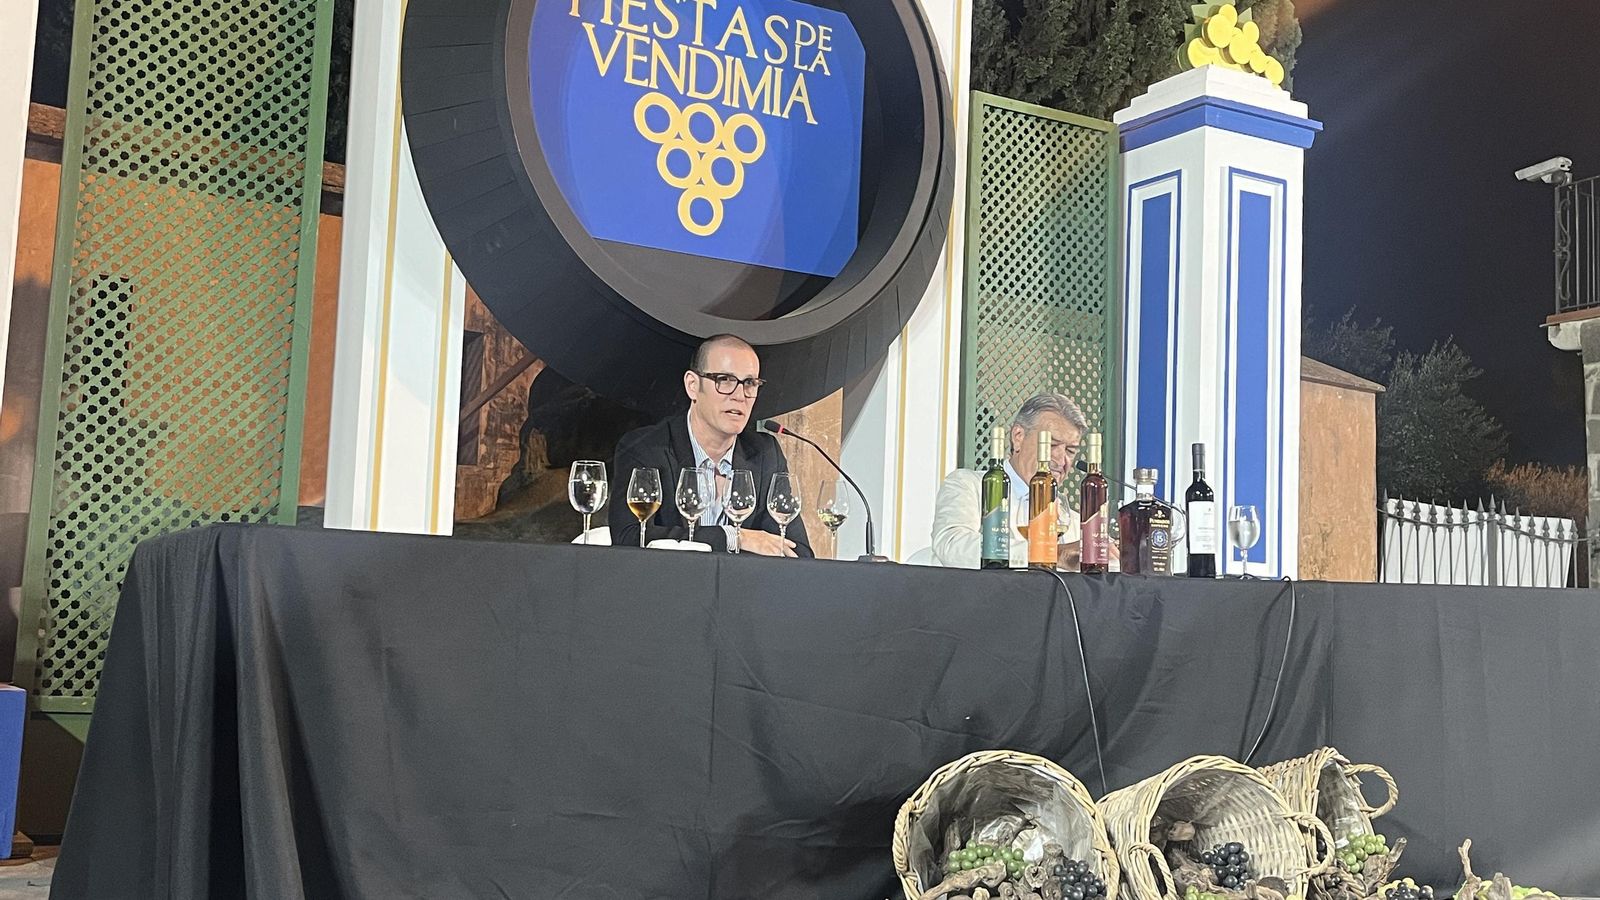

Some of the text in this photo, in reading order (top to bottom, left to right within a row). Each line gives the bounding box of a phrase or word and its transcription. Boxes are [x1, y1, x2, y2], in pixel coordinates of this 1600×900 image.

[795, 19, 833, 52] DE
[582, 22, 818, 125] VENDIMIA
[793, 43, 831, 76] LA
